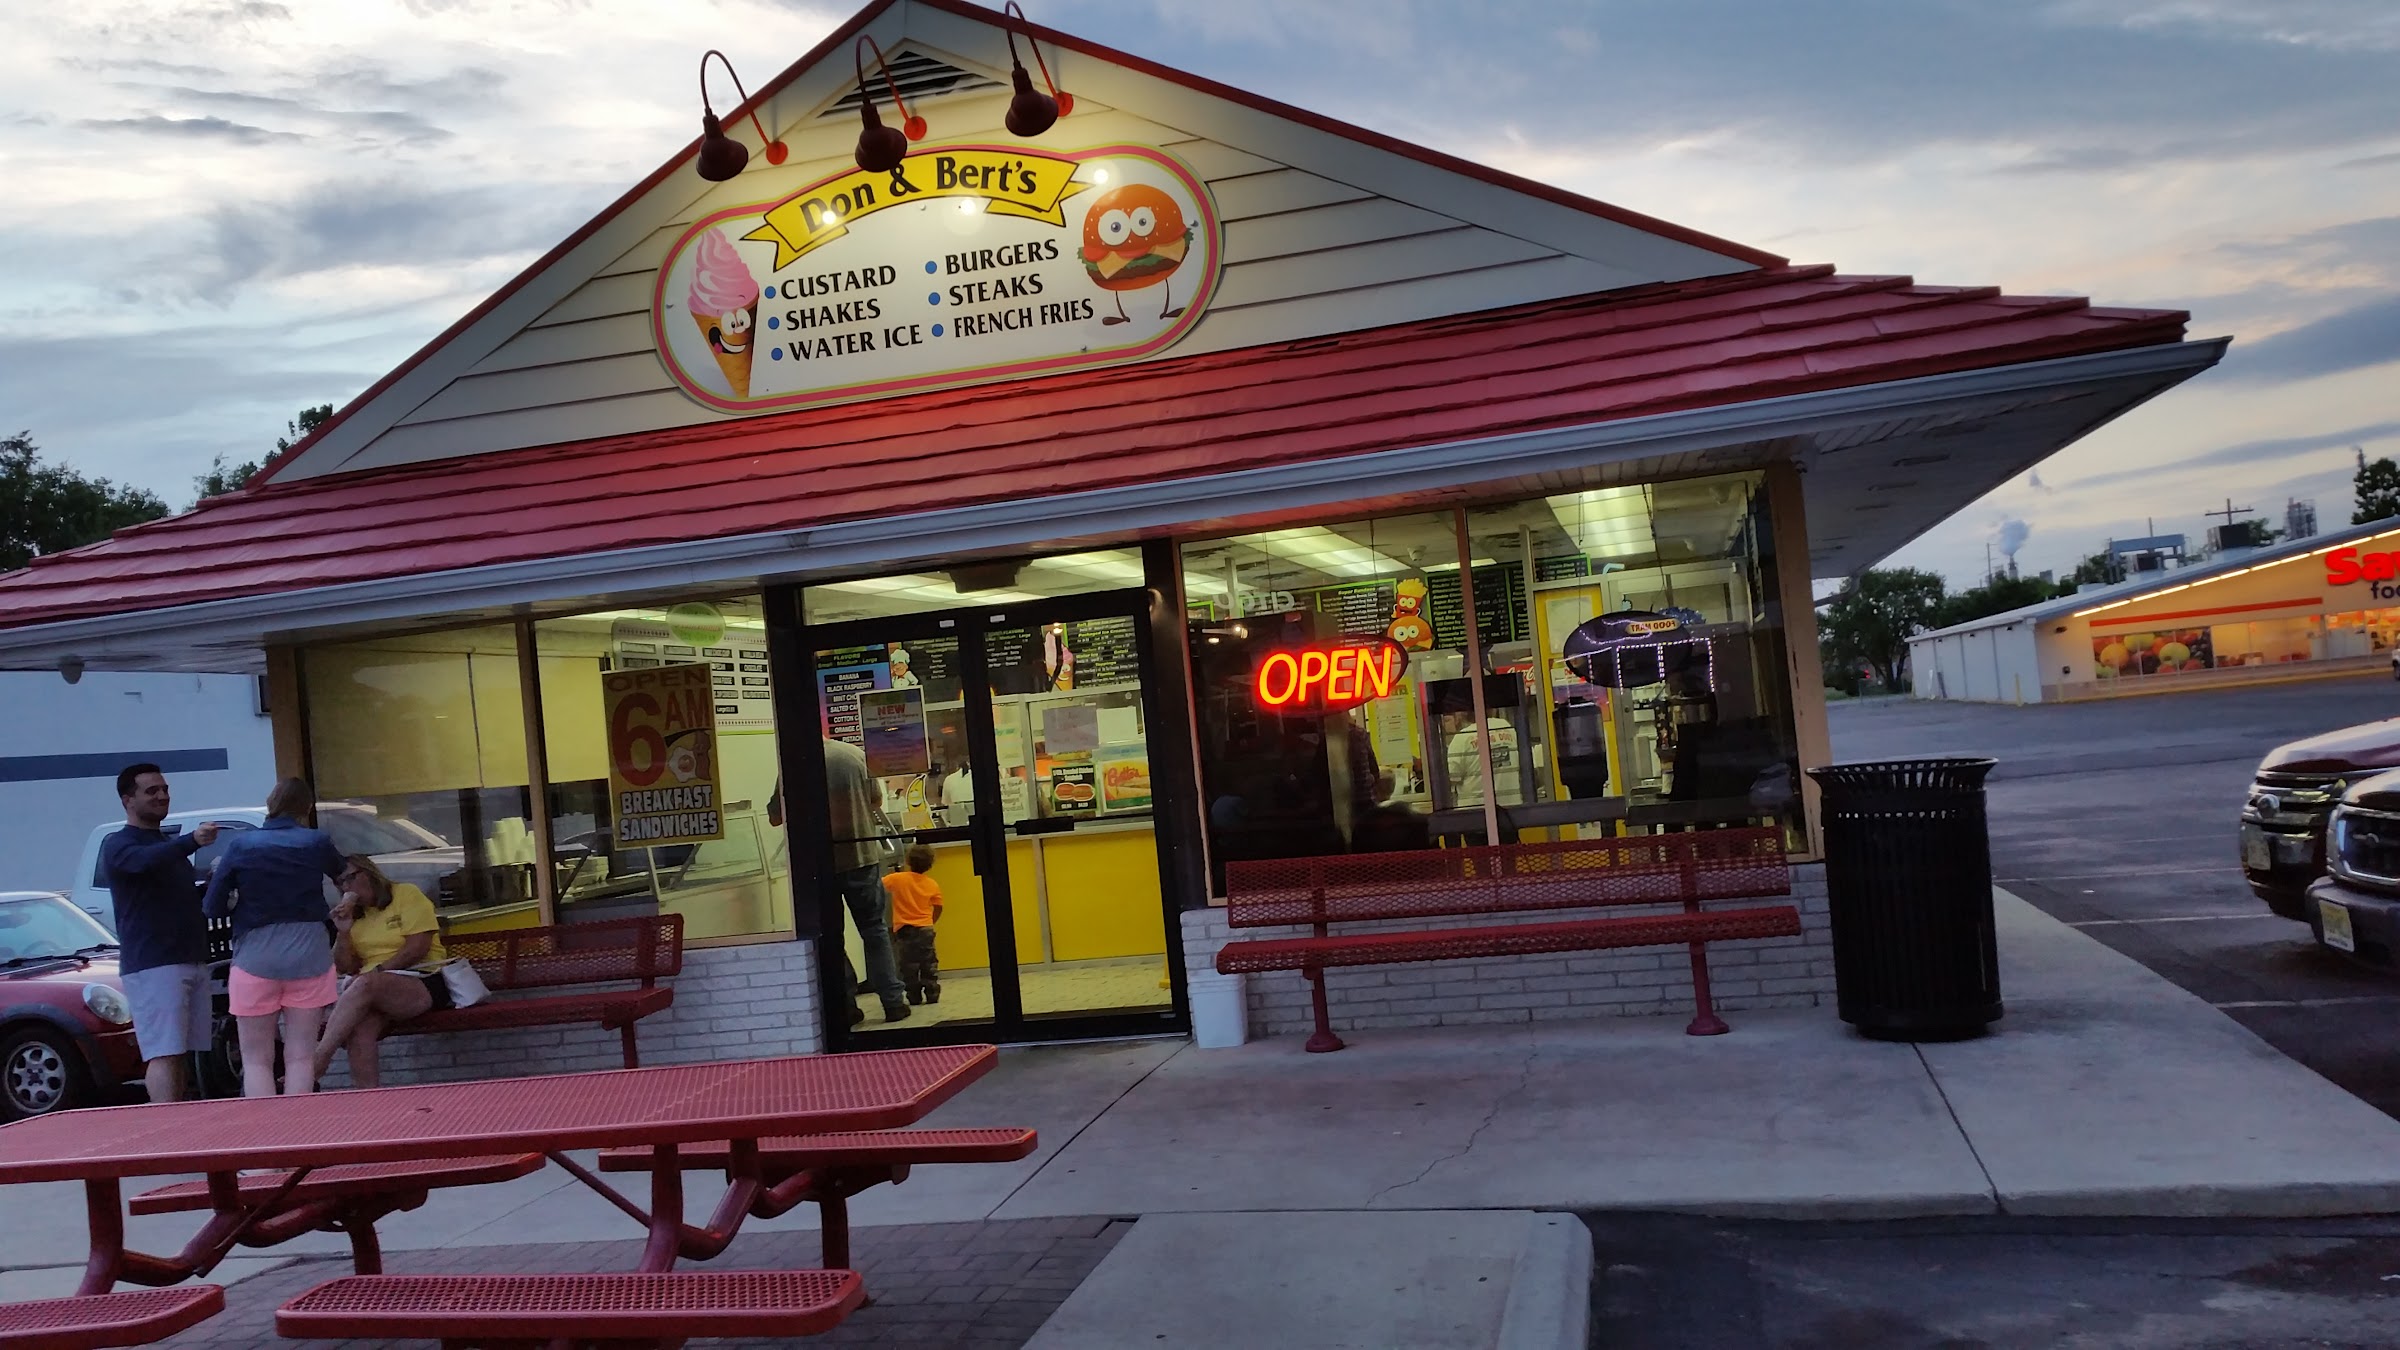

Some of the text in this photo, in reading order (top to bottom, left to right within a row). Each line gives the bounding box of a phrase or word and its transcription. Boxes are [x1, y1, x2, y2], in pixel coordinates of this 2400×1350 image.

[800, 156, 1037, 235] Don & Bert's
[945, 238, 1059, 276] BURGERS
[780, 264, 897, 300] CUSTARD
[949, 273, 1043, 307] STEAKS
[786, 299, 881, 331] SHAKES
[953, 298, 1094, 338] FRENCH FRIES
[789, 323, 923, 362] WATER ICE
[606, 668, 708, 692] OPEN
[826, 681, 873, 693] BLACK RASPBERRY
[838, 672, 860, 681] BANANA
[1256, 644, 1395, 706] OPEN
[830, 705, 849, 714] SALTED
[833, 716, 854, 724] COTTON
[877, 703, 906, 716] NEW
[611, 687, 711, 787] 6 AM
[834, 726, 855, 734] ORANGE
[621, 785, 713, 815] BREAKFAST
[620, 811, 718, 841] SANDWICHES
